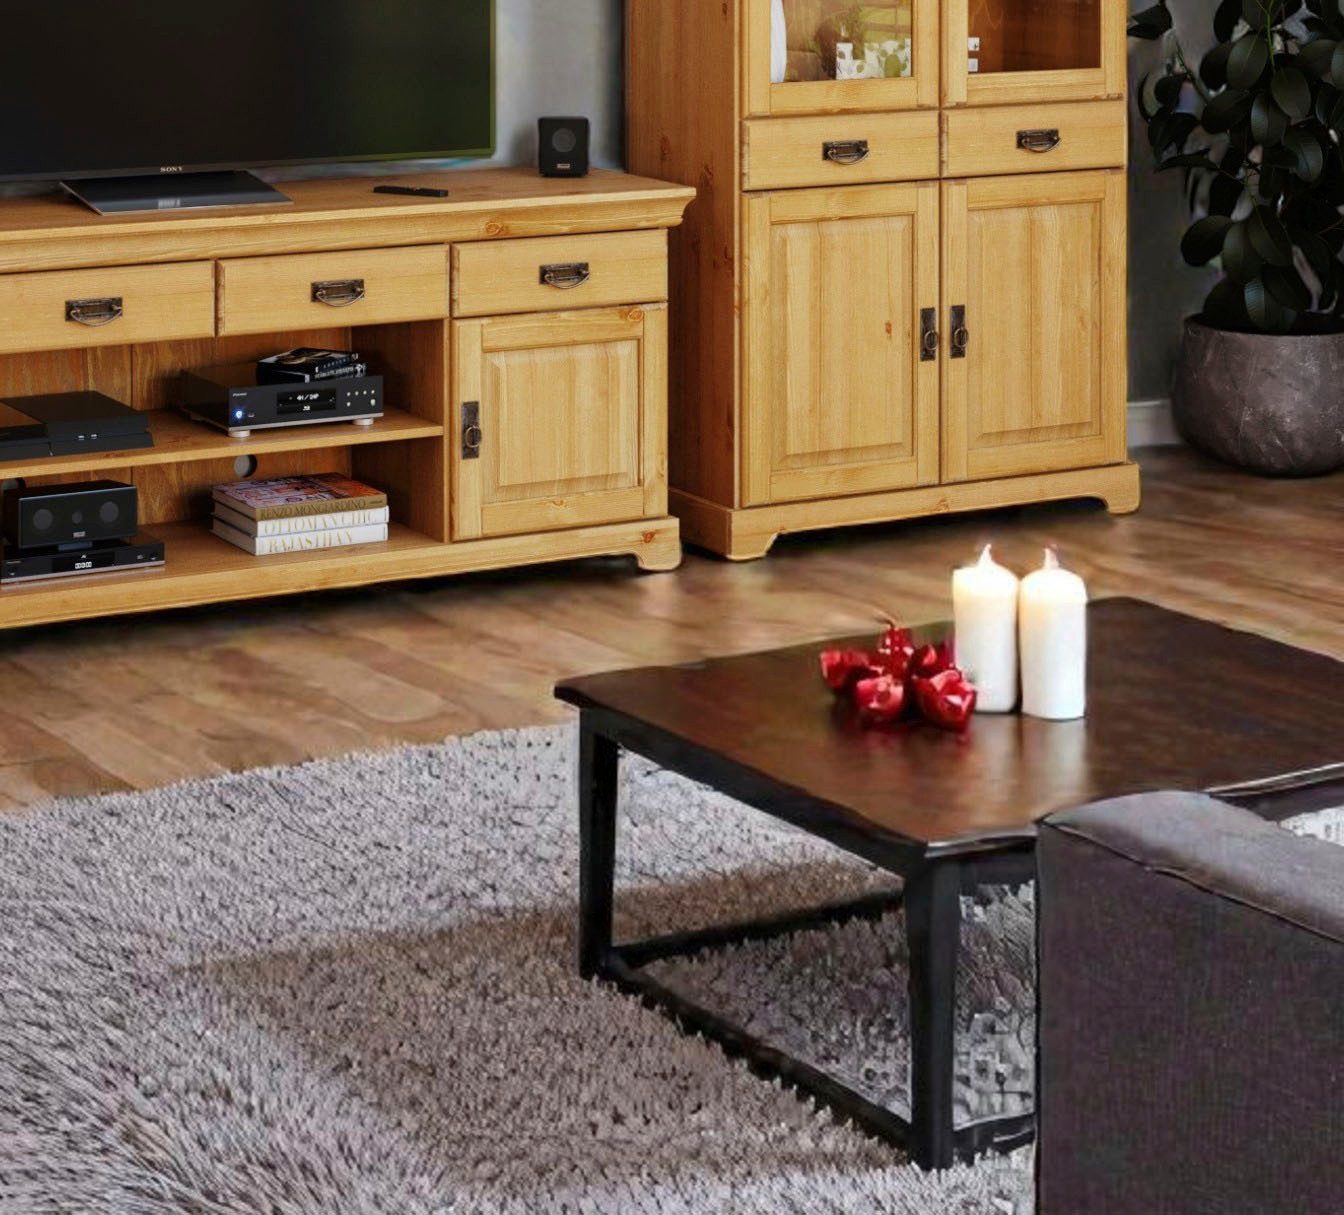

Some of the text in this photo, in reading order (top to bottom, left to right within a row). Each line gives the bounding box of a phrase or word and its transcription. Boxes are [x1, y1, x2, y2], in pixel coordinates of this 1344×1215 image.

[261, 506, 294, 520] RENZO
[264, 511, 372, 534] OTTOMAN CHIC
[269, 530, 353, 553] RAJASTHAN
